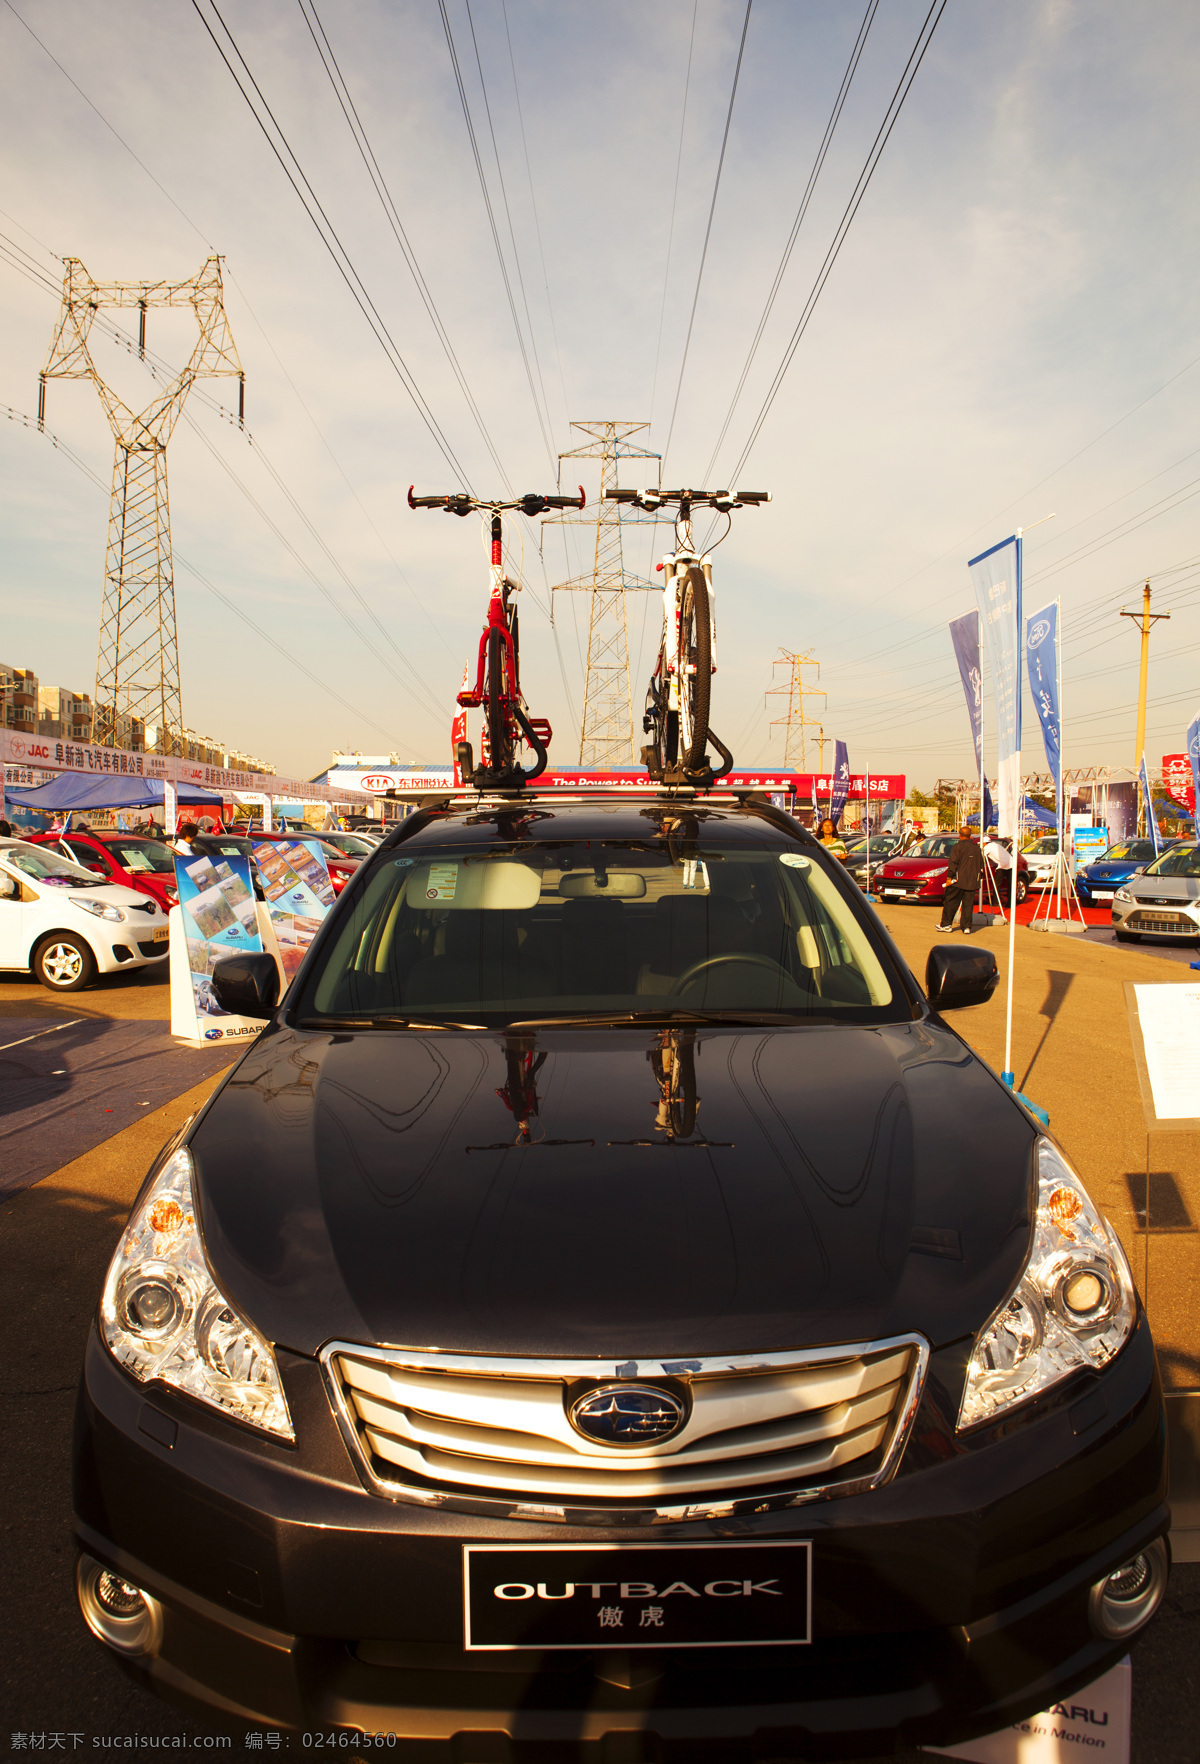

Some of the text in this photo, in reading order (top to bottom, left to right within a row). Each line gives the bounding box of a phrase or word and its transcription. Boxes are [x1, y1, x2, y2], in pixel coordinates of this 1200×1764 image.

[28, 744, 49, 758] JAC
[55, 743, 143, 775] 阜新渤飞汽车有限公司
[191, 769, 203, 779] JAC
[366, 779, 390, 788] KIA
[493, 1579, 783, 1600] OUTBACK
[597, 1606, 665, 1628] 傲虎
[1033, 1724, 1047, 1735] in
[1050, 1727, 1106, 1748] Motion
